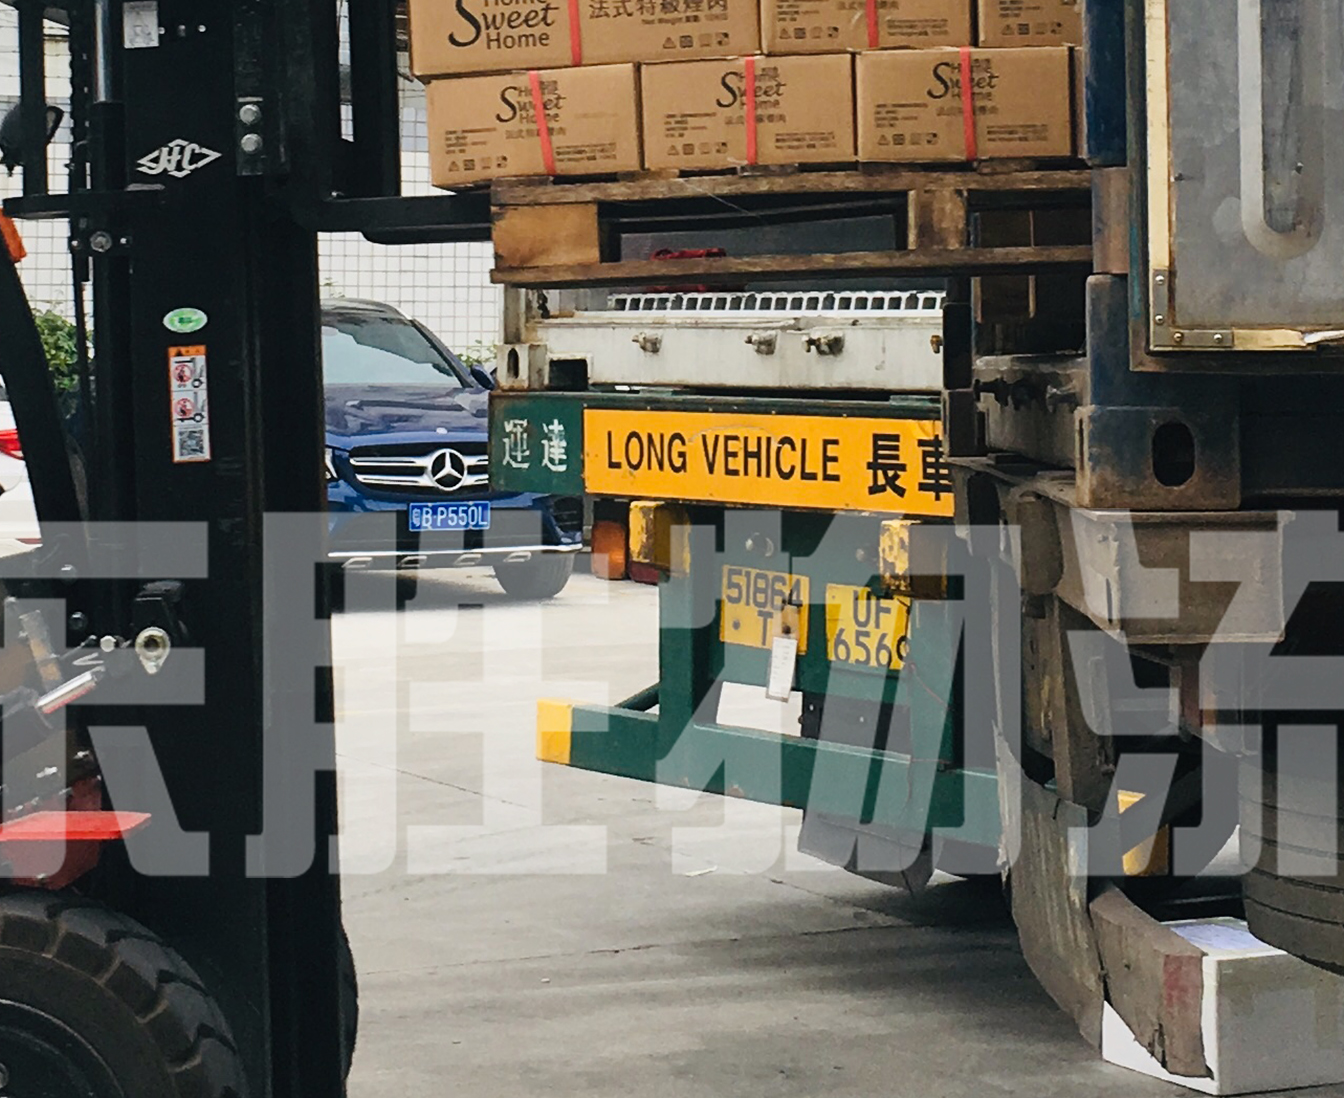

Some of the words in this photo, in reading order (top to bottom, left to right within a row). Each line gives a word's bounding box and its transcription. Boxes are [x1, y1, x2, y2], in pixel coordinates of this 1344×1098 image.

[486, 32, 550, 50] Home
[927, 62, 998, 98] Swet
[950, 92, 992, 102] Hme
[496, 85, 567, 122] Swet
[519, 112, 560, 124] Hoe
[739, 99, 780, 110] Hme
[502, 418, 568, 473] 運達
[607, 430, 687, 474] LONG
[702, 433, 841, 483] VEHICLE
[726, 568, 804, 611] 51864
[757, 609, 774, 646] T
[853, 589, 892, 629] UF
